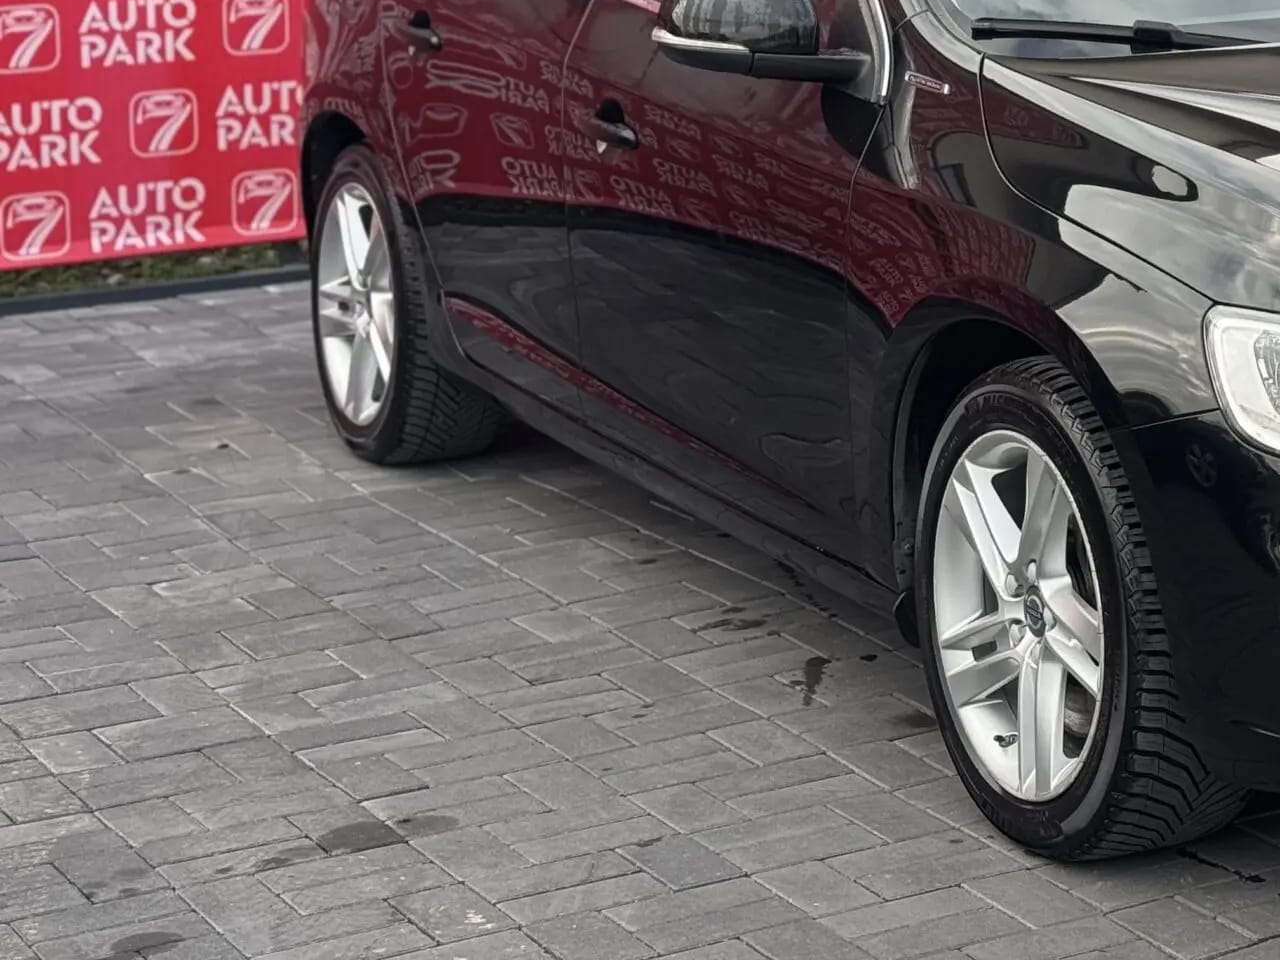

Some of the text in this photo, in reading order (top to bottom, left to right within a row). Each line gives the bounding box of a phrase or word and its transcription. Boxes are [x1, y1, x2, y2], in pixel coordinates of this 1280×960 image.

[80, 28, 196, 68] PARK
[90, 177, 206, 216] AUTO
[90, 212, 206, 253] PARK
